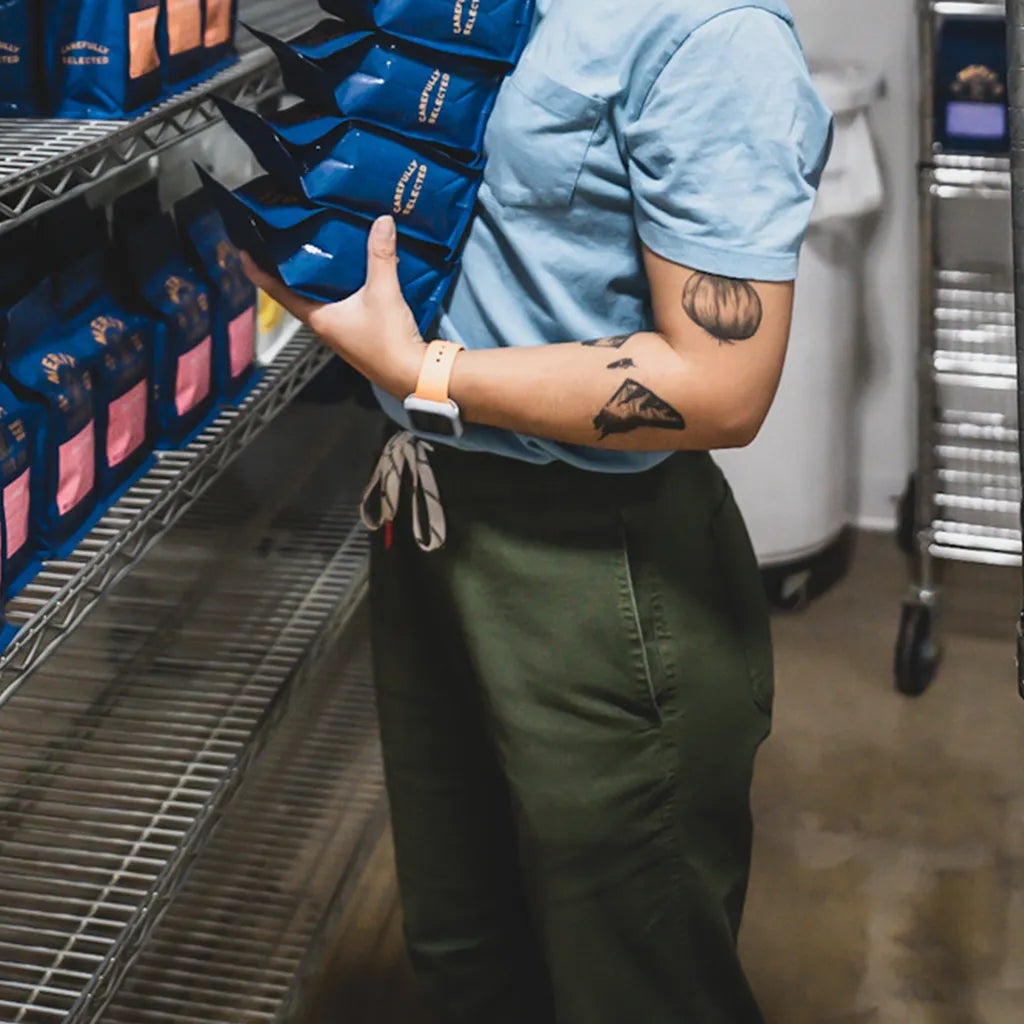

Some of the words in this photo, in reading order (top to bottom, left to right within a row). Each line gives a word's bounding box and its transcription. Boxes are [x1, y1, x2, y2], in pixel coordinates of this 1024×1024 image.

[418, 69, 440, 123] CAREFULLY
[428, 73, 450, 125] SELECTED
[393, 159, 418, 213] CAREFULLY
[402, 164, 428, 215] SELECTED
